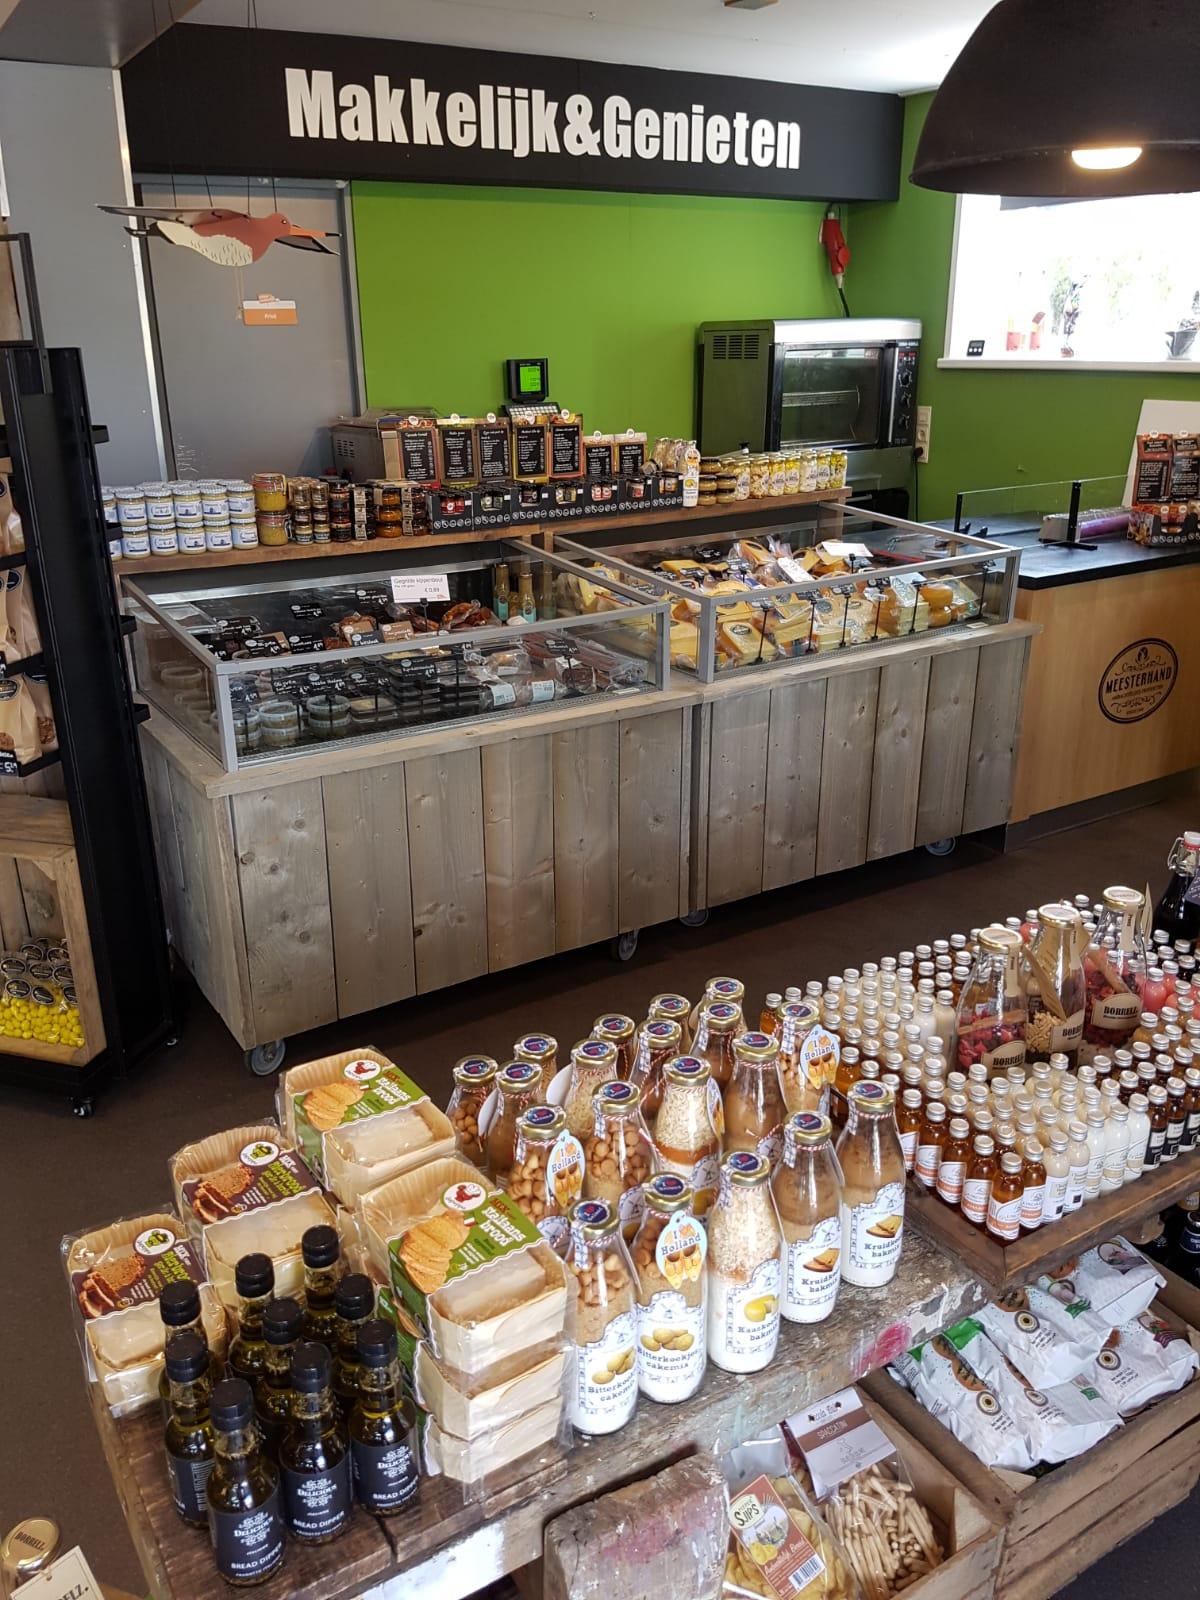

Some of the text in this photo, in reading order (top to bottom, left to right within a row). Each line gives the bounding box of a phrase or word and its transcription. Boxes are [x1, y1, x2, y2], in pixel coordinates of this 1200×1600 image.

[285, 67, 802, 170] Makkelijk&Genieten
[1105, 667, 1173, 694] MEESTERHAND
[804, 1043, 836, 1061] Holland
[551, 1152, 582, 1174] Holland
[661, 1233, 702, 1255] Holland
[318, 1510, 346, 1529] DIPPER
[231, 1559, 259, 1570] BREAD
